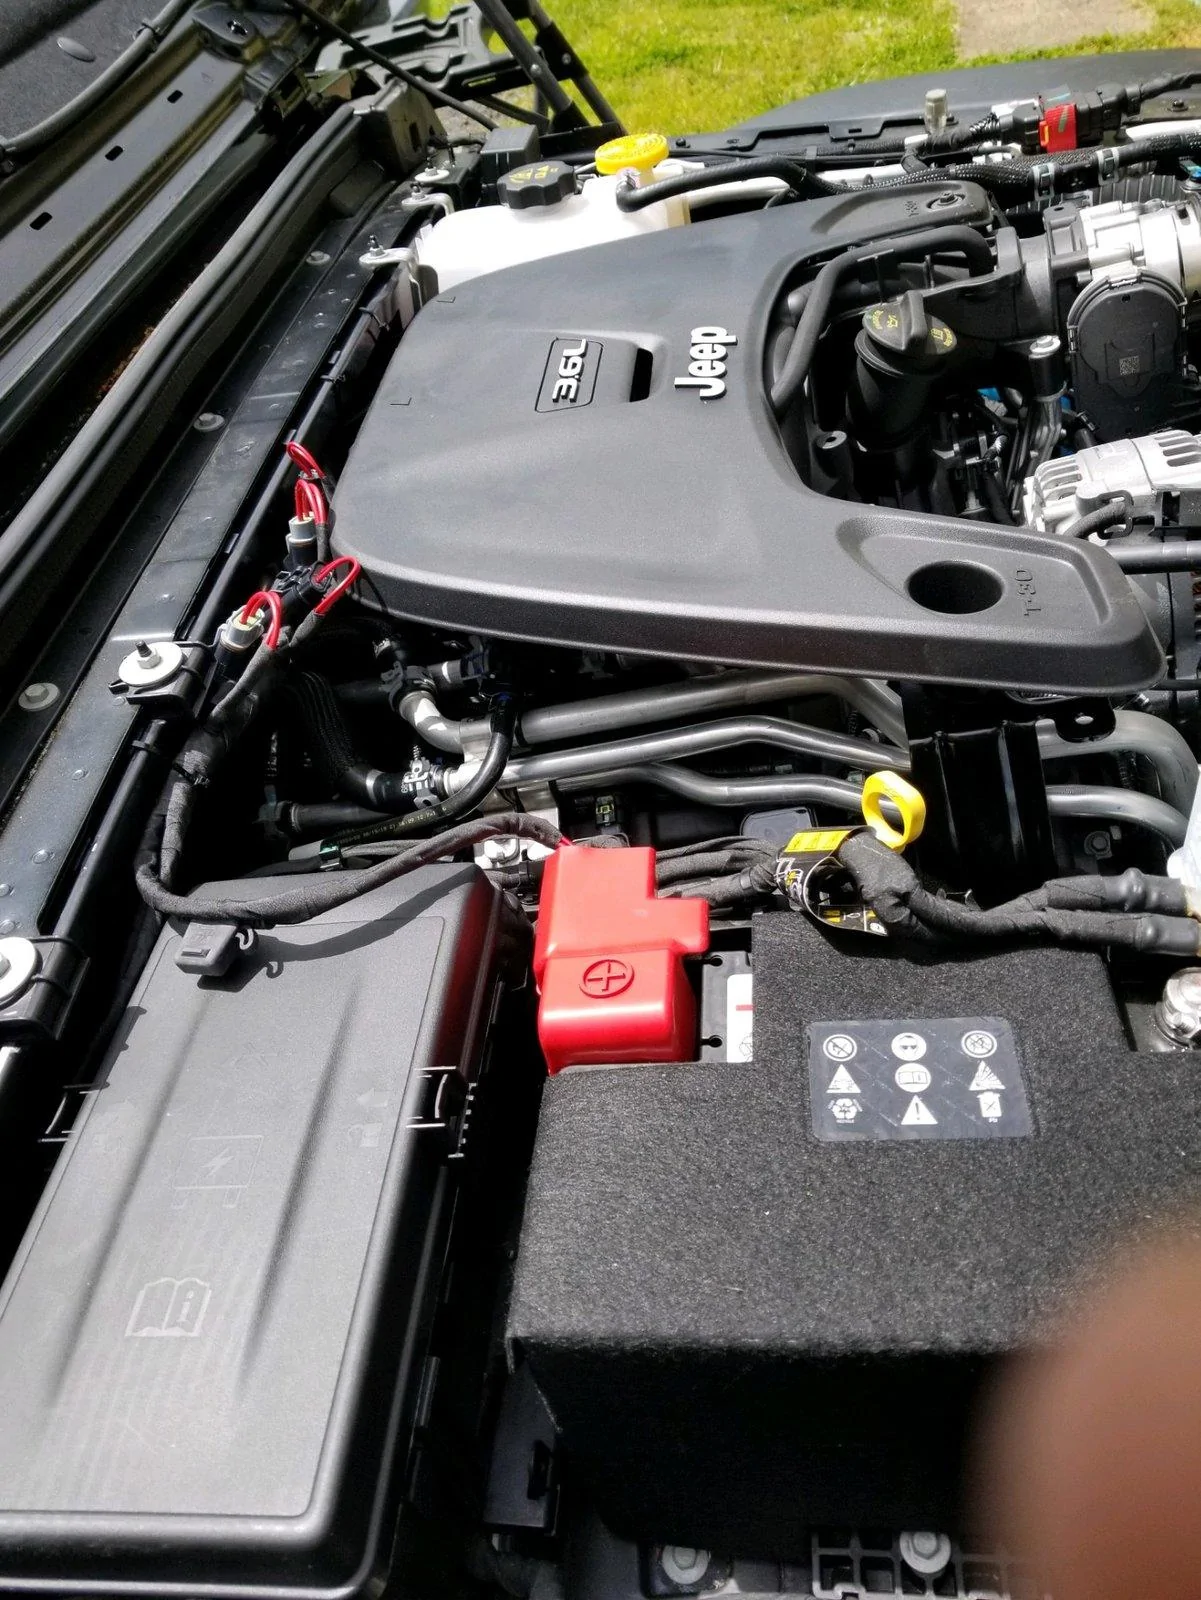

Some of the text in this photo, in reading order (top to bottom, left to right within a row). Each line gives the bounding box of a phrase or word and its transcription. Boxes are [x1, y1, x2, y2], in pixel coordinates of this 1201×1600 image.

[552, 338, 588, 402] 3.6L
[673, 326, 737, 400] Jeep
[1014, 569, 1042, 616] T-30
